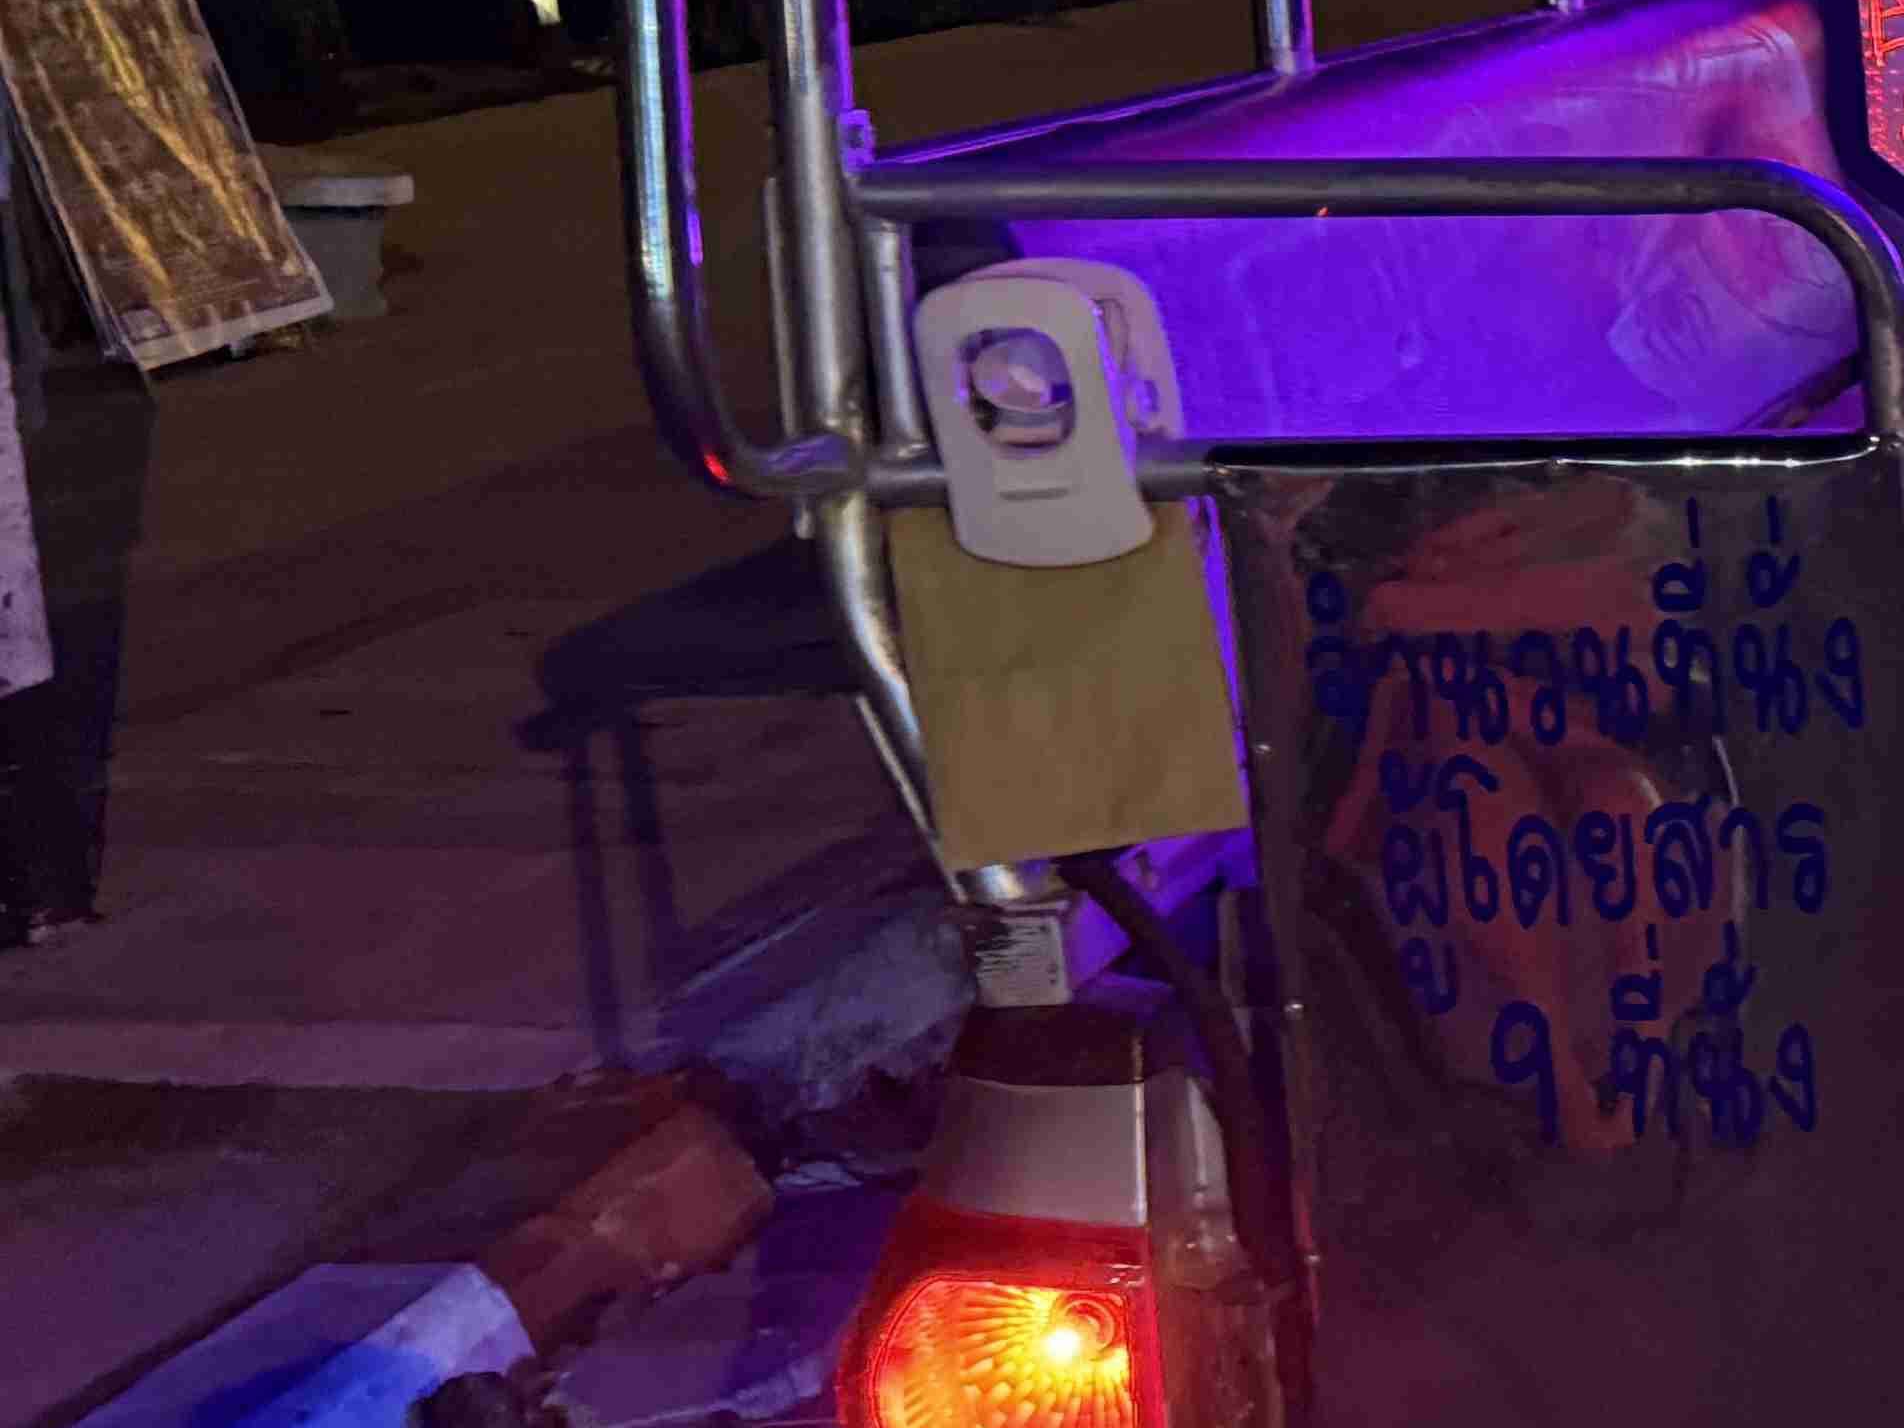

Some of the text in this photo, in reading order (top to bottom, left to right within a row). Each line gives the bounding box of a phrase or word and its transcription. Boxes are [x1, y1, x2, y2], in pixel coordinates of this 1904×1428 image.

[1379, 750, 1829, 1014] ผู้โดยสาร
[1611, 924, 1817, 1142] ที่นั่ง
